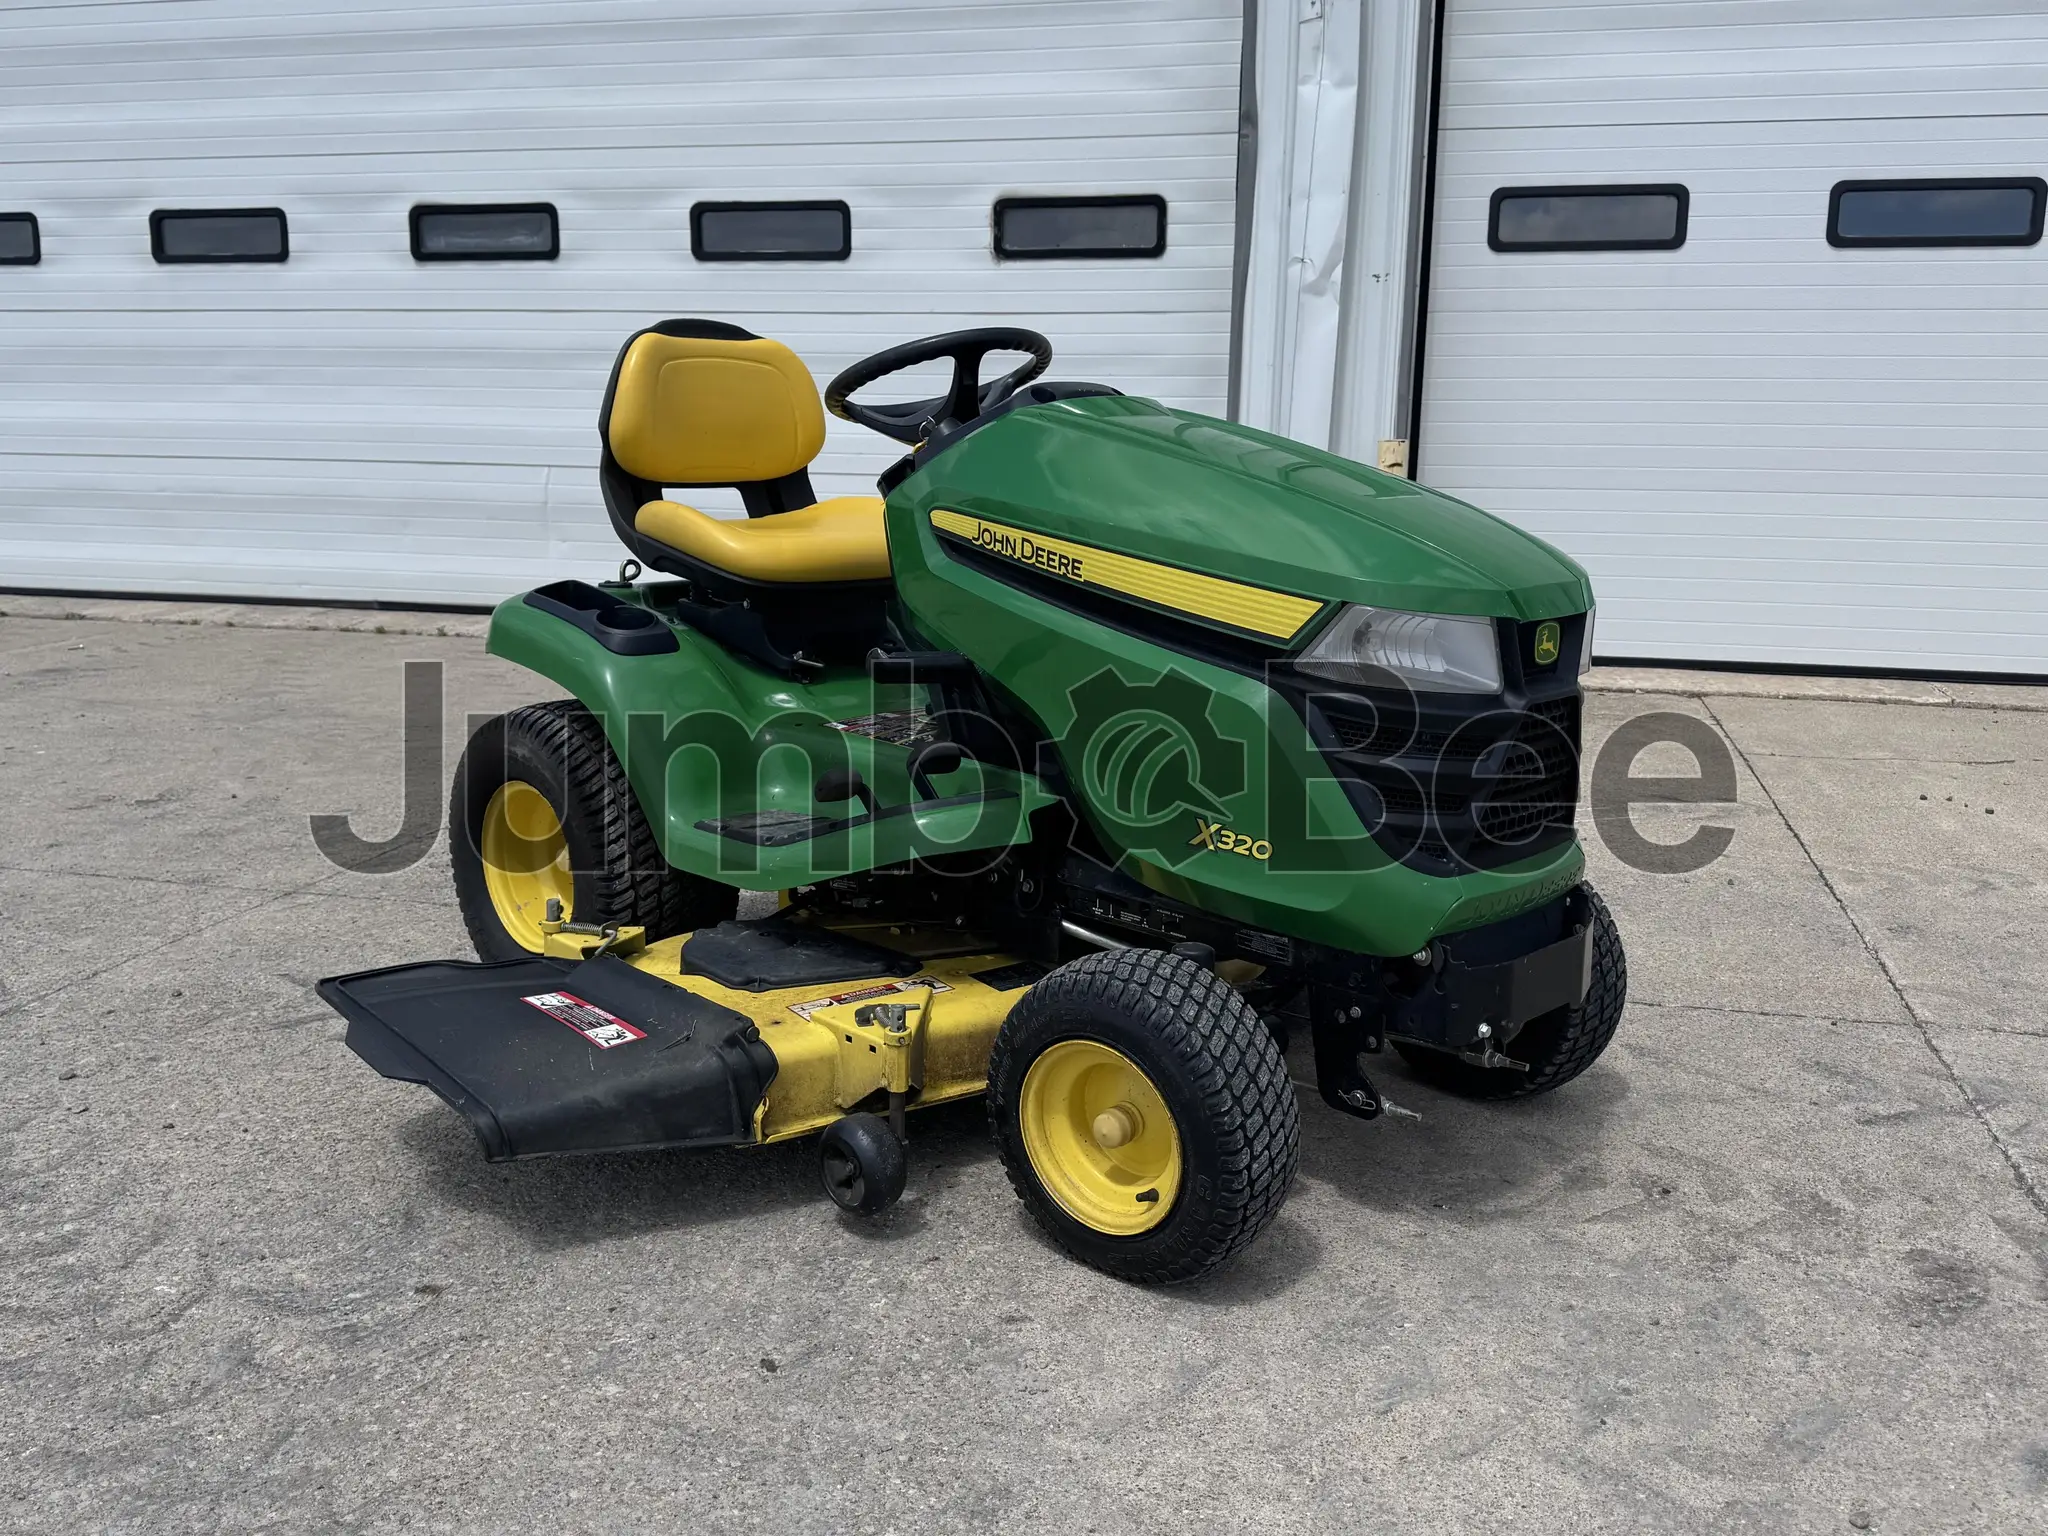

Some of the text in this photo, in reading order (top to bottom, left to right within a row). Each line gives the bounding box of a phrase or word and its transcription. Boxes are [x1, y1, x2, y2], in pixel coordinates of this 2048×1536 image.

[971, 521, 1084, 580] JOHN DEERE
[1188, 817, 1274, 861] X320
